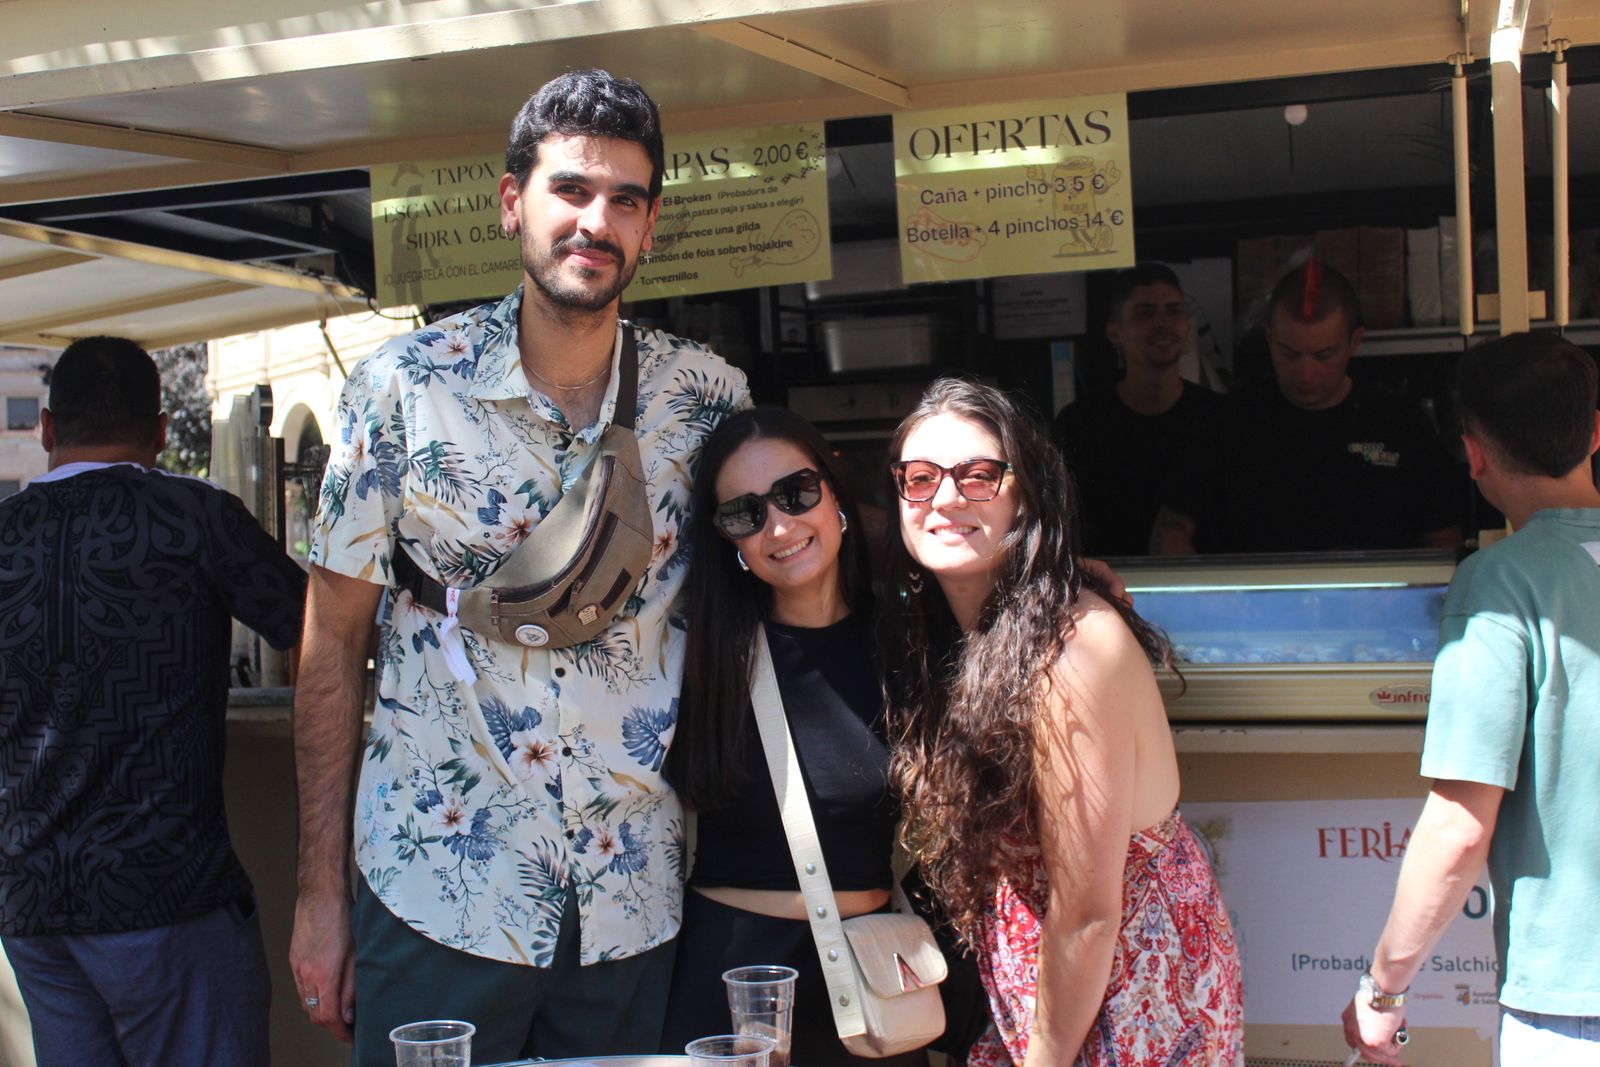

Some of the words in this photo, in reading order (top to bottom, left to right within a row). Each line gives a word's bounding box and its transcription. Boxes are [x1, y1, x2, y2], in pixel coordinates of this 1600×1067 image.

[909, 110, 1112, 161] OFERTAS
[753, 143, 792, 168] 2,00
[795, 141, 808, 161] €
[675, 191, 712, 206] Broken
[767, 184, 779, 194] de
[920, 186, 968, 206] Caña
[985, 180, 1049, 204] pincho
[1091, 174, 1105, 190] €
[692, 205, 720, 220] patata
[720, 203, 739, 217] paja
[740, 204, 745, 213] y
[746, 200, 769, 212] salsa
[656, 230, 675, 246] que
[677, 227, 713, 243] parece
[714, 224, 734, 236] una
[736, 220, 761, 237] gilda
[907, 224, 969, 243] Botella
[988, 219, 1001, 237] 4
[1005, 214, 1079, 239] pinchos
[1084, 210, 1105, 230] 14
[1110, 209, 1124, 226] €
[406, 229, 463, 252] SIDRA
[681, 249, 695, 262] de
[717, 243, 748, 257] sobre
[445, 264, 467, 278] CON
[468, 262, 480, 276] EL
[640, 270, 699, 287] Torreznillos
